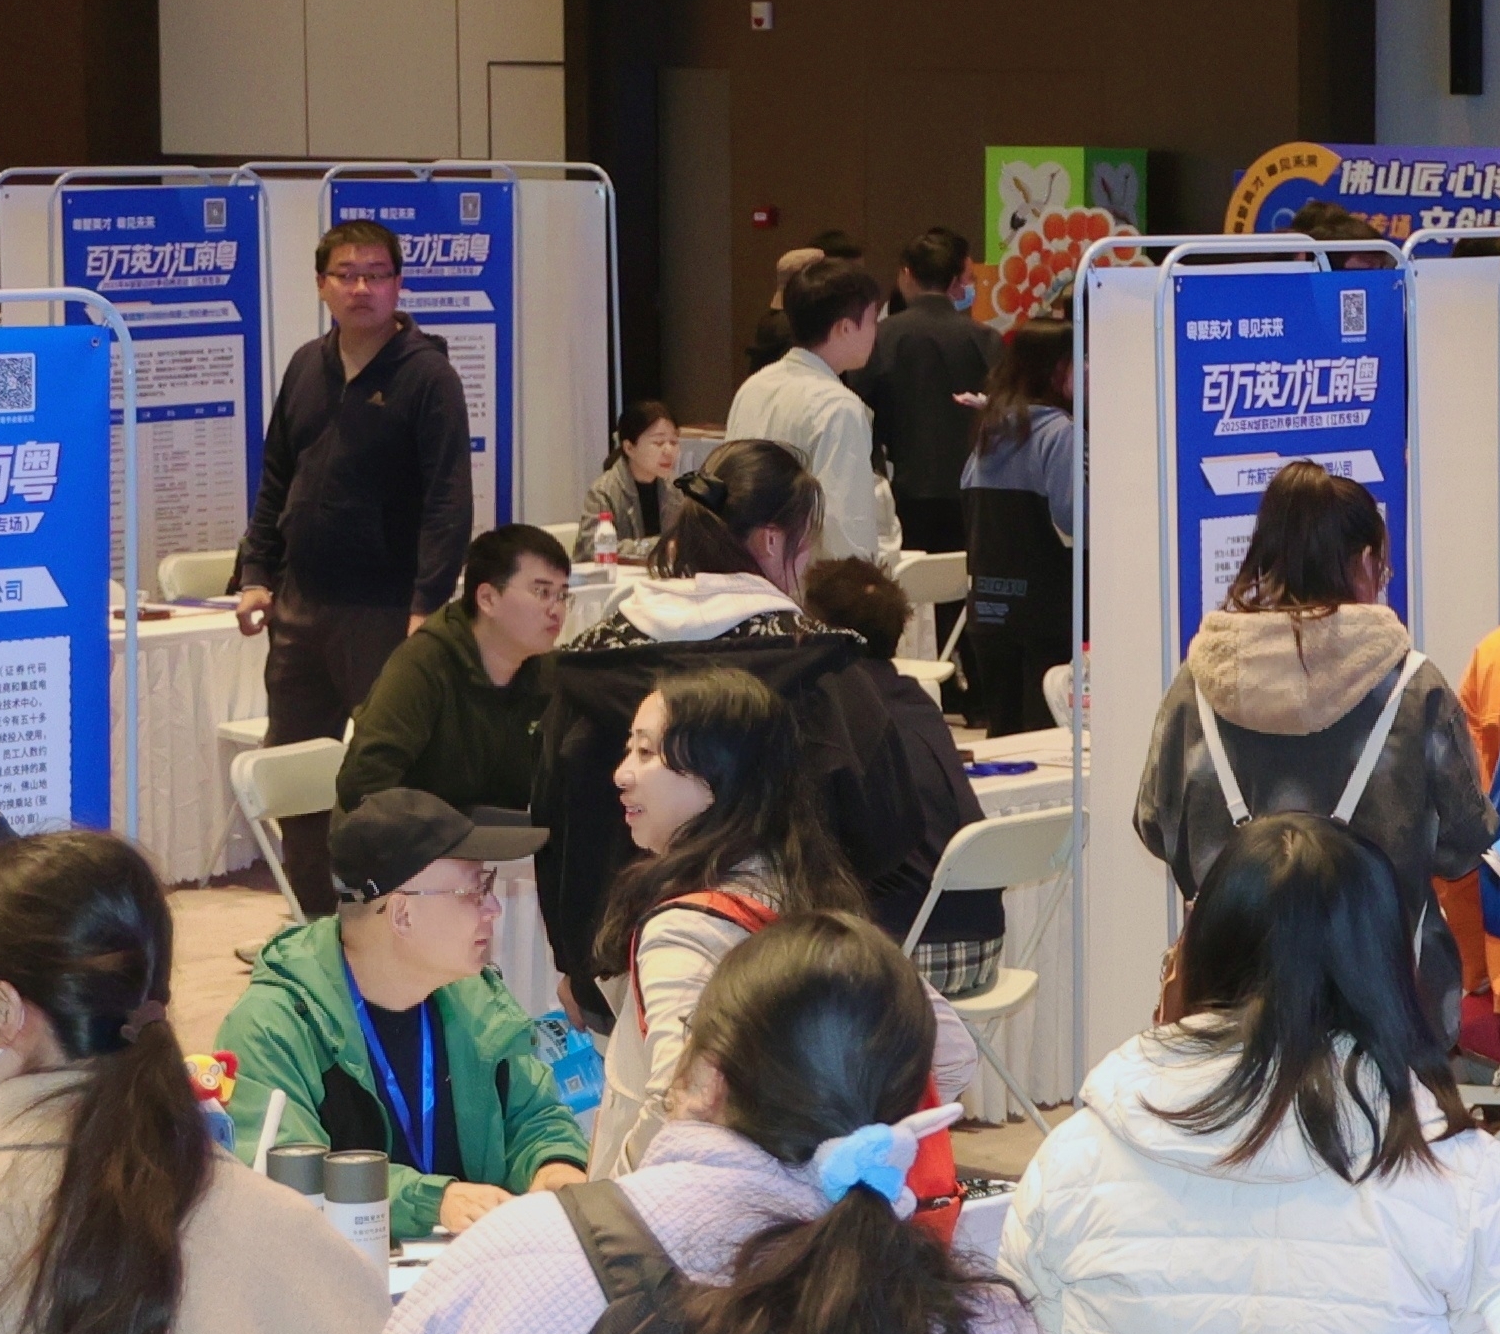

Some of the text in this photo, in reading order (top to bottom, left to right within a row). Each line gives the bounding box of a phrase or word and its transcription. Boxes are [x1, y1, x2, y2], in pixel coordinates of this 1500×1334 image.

[1351, 211, 1412, 239] 专场
[86, 240, 238, 281] 百万英才汇南粤
[1202, 355, 1379, 418] 百万英才汇南粤
